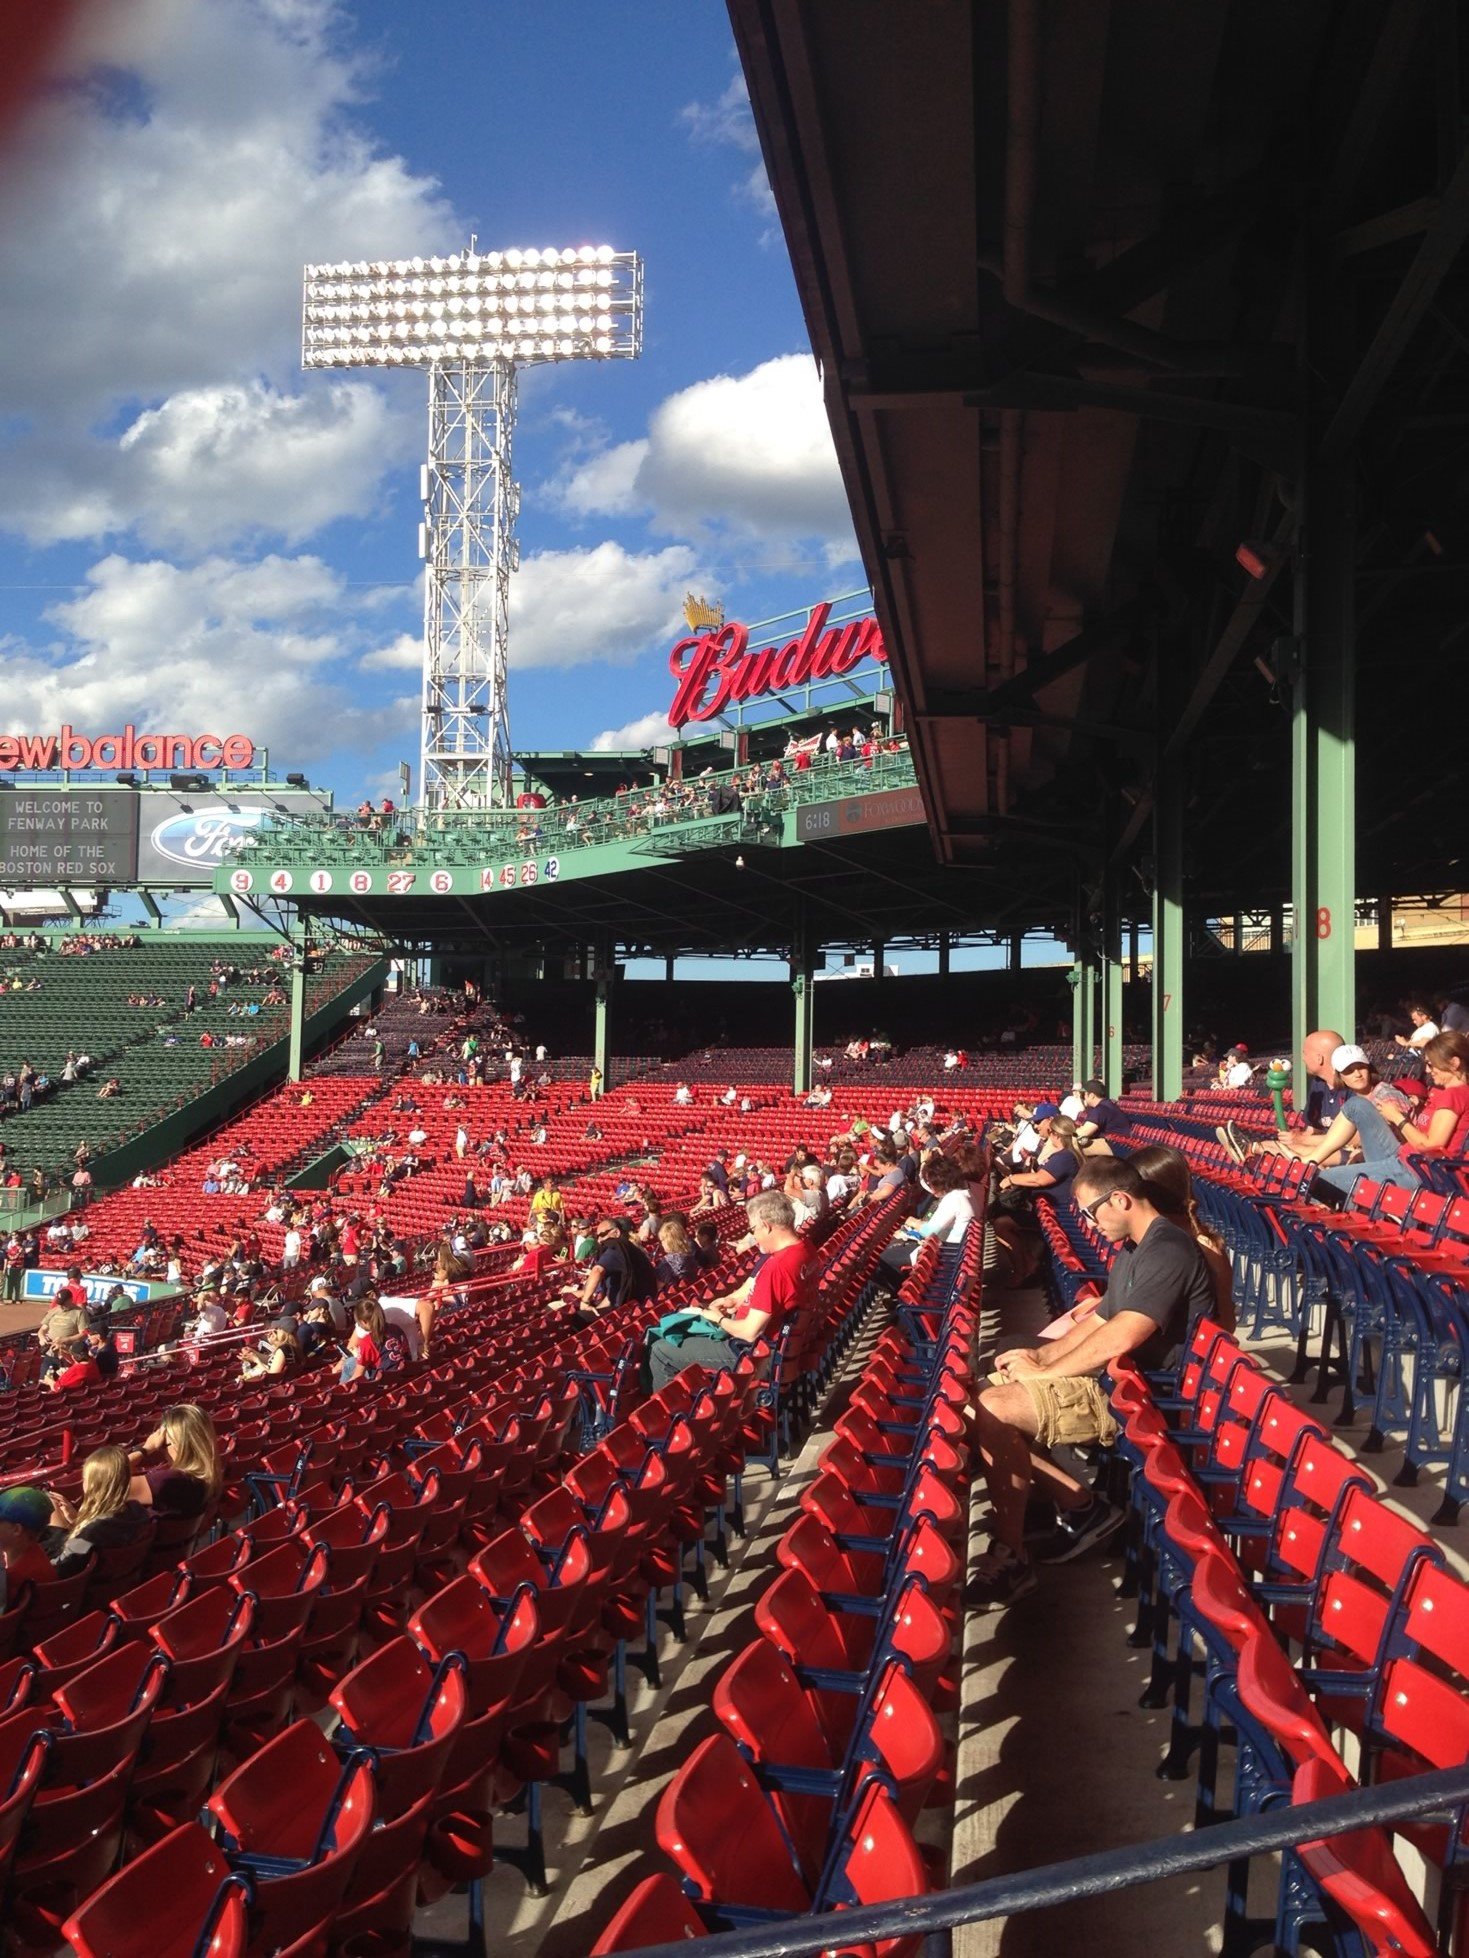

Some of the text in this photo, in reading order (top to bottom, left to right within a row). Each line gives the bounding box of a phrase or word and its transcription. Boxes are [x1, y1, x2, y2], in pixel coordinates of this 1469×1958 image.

[61, 725, 254, 769] balance
[15, 801, 103, 813] WELCOME TO
[8, 818, 108, 830] FENWAY PARK
[805, 811, 830, 830] 6:18
[10, 845, 105, 858] HOME OF THE
[57, 862, 83, 874] RED
[89, 862, 115, 875] SOX
[235, 873, 249, 890] 9
[274, 873, 287, 890] 4
[354, 874, 368, 891] 8
[386, 872, 416, 892] 27
[434, 873, 449, 891] 6
[480, 871, 492, 889] 14
[499, 867, 515, 885] 45
[520, 864, 537, 884] 26
[544, 860, 557, 878] 42
[1316, 906, 1331, 940] 8
[1162, 993, 1171, 1012] 7
[1108, 1025, 1115, 1038] 6
